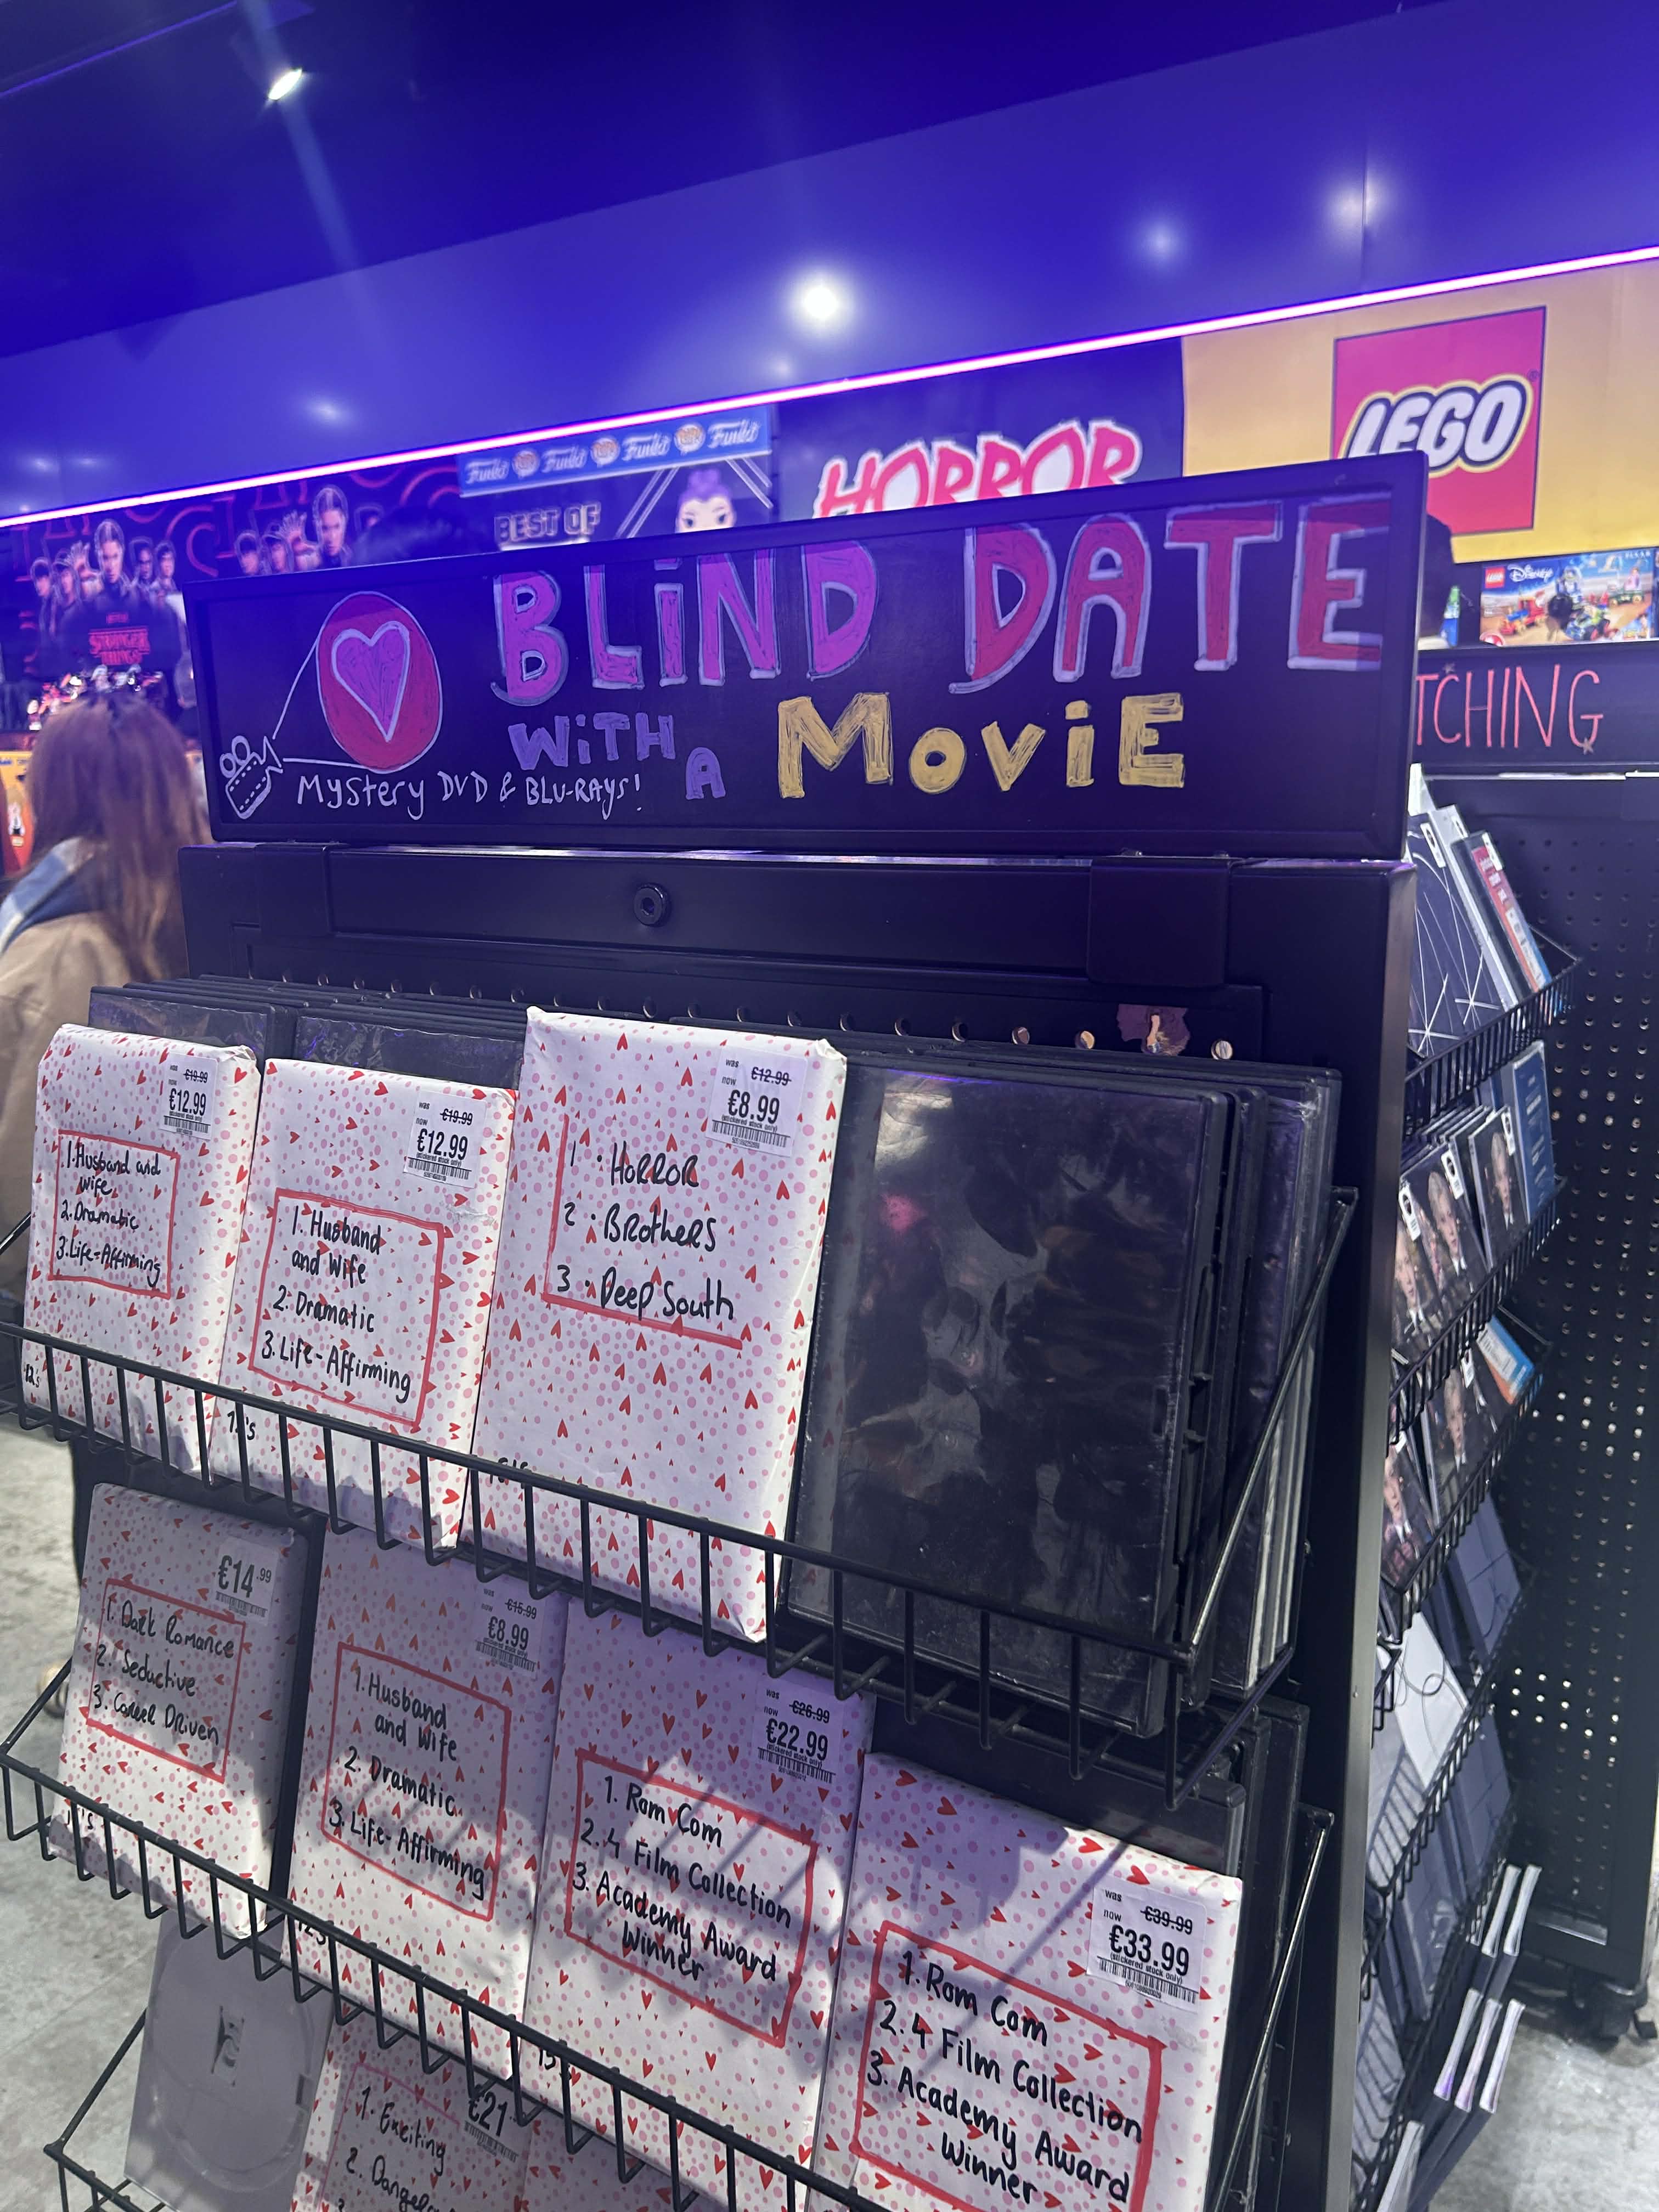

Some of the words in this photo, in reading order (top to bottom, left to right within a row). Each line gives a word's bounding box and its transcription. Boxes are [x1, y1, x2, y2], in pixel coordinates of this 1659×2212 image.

[1342, 377, 1530, 473] LEGO
[812, 419, 1141, 518] HORROR
[494, 508, 561, 544] BEST
[564, 501, 601, 534] OF
[949, 492, 1392, 693] DATE
[437, 771, 488, 803] DVD
[500, 773, 515, 804] &
[686, 747, 726, 800] A
[183, 1069, 208, 1084] €19.99
[721, 1076, 736, 1086] now
[725, 1059, 739, 1068] was
[751, 1066, 792, 1086] €12.99
[169, 1088, 206, 1116] €12.99
[419, 1102, 430, 1110] was
[440, 1108, 473, 1125] €19.99
[727, 1089, 780, 1124] €8.99
[136, 1153, 161, 1175] and
[417, 1128, 468, 1160] €12.99
[311, 1209, 382, 1255] Husband
[291, 1249, 320, 1276] and
[329, 1251, 366, 1288] Wife
[296, 1291, 375, 1333] Dramatic
[662, 1277, 734, 1321] South
[505, 1598, 537, 1619] €15.99
[166, 1615, 235, 1658] Romance
[488, 1616, 529, 1650] €8.99
[122, 1649, 196, 1697] Seductive
[369, 1672, 448, 1730] Husband
[764, 1706, 778, 1717] now
[766, 1689, 780, 1699] was
[789, 1700, 830, 1723] €26.99
[375, 1714, 407, 1746] and
[766, 1718, 828, 1760] €22.99
[371, 1755, 455, 1816] Dramatic
[677, 1803, 722, 1848] Com
[634, 1839, 680, 1884] Film
[689, 1862, 791, 1929] Collection
[596, 1870, 692, 1955] Academy
[704, 1921, 777, 1982] Award
[1103, 1909, 1122, 1922] now
[1105, 1889, 1122, 1902] was
[1140, 1905, 1193, 1935] €39.99
[622, 1921, 705, 1981] Winner
[1109, 1924, 1189, 1977] €33.99
[1110, 1953, 1143, 1970] (stickered
[1146, 1965, 1164, 1977] stock
[1166, 1972, 1183, 1985] only)
[991, 1995, 1048, 2047] Com
[941, 2028, 1001, 2085] Film
[1013, 2059, 1142, 2144] Collection
[898, 2067, 1017, 2171] Academy
[1035, 2131, 1130, 2203] Award
[941, 2132, 1039, 2205] Winner
